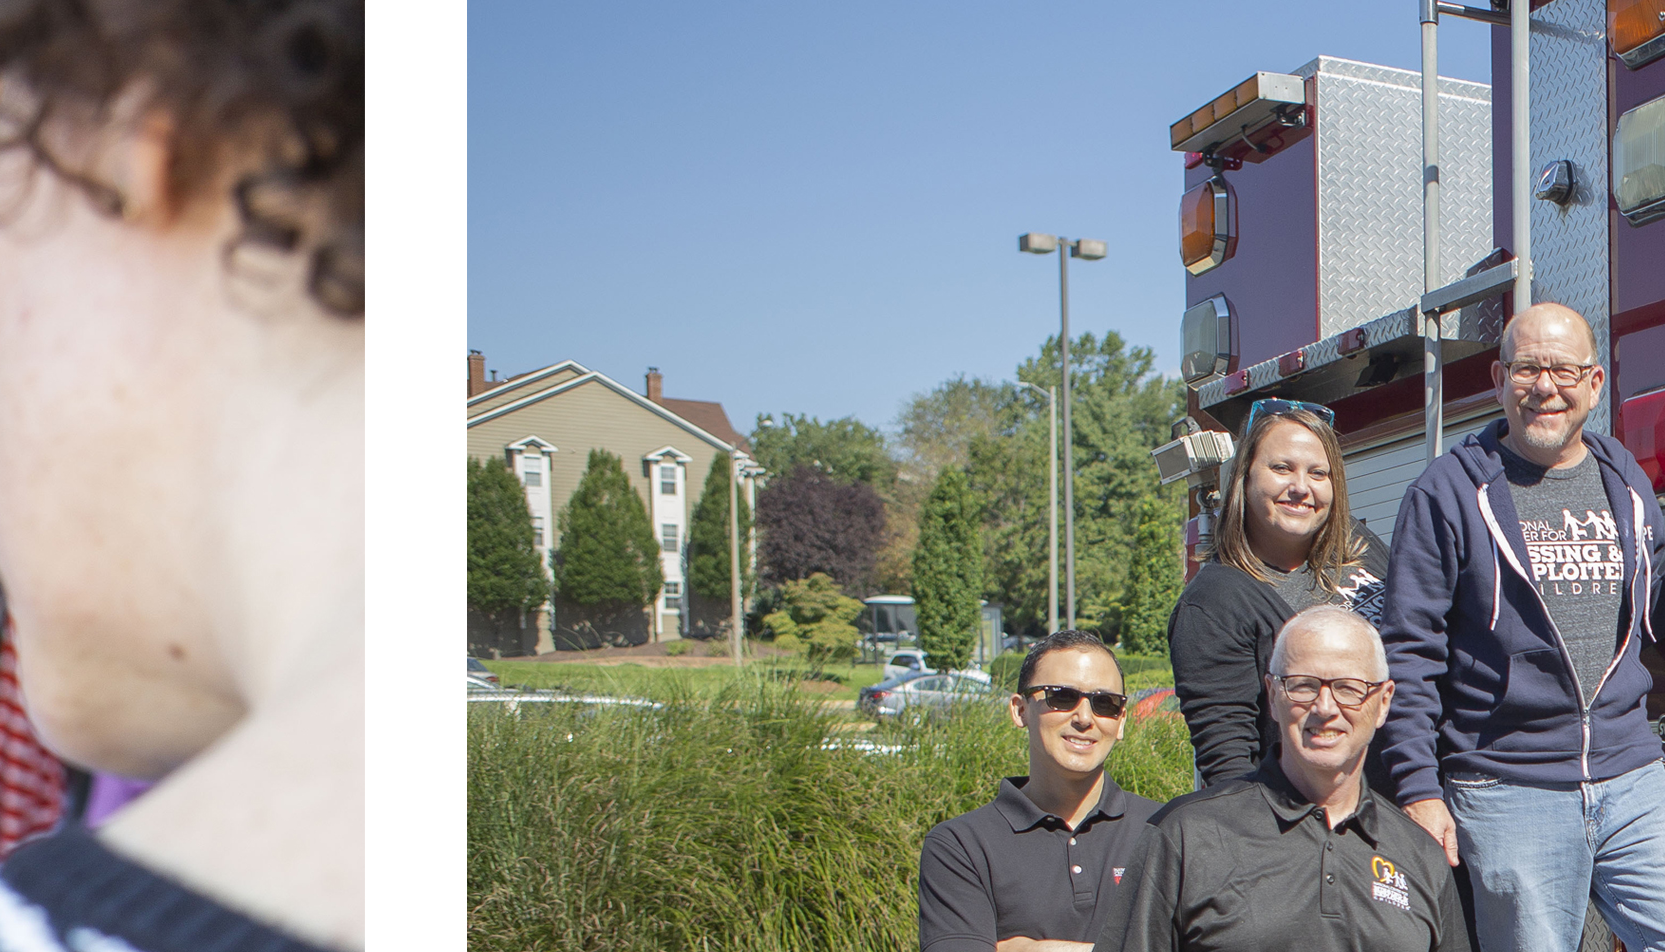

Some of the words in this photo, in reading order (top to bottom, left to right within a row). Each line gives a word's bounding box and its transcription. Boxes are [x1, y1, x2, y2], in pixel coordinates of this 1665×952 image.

[1542, 531, 1567, 541] FOR
[1527, 545, 1601, 563] SSING
[1608, 545, 1623, 562] &
